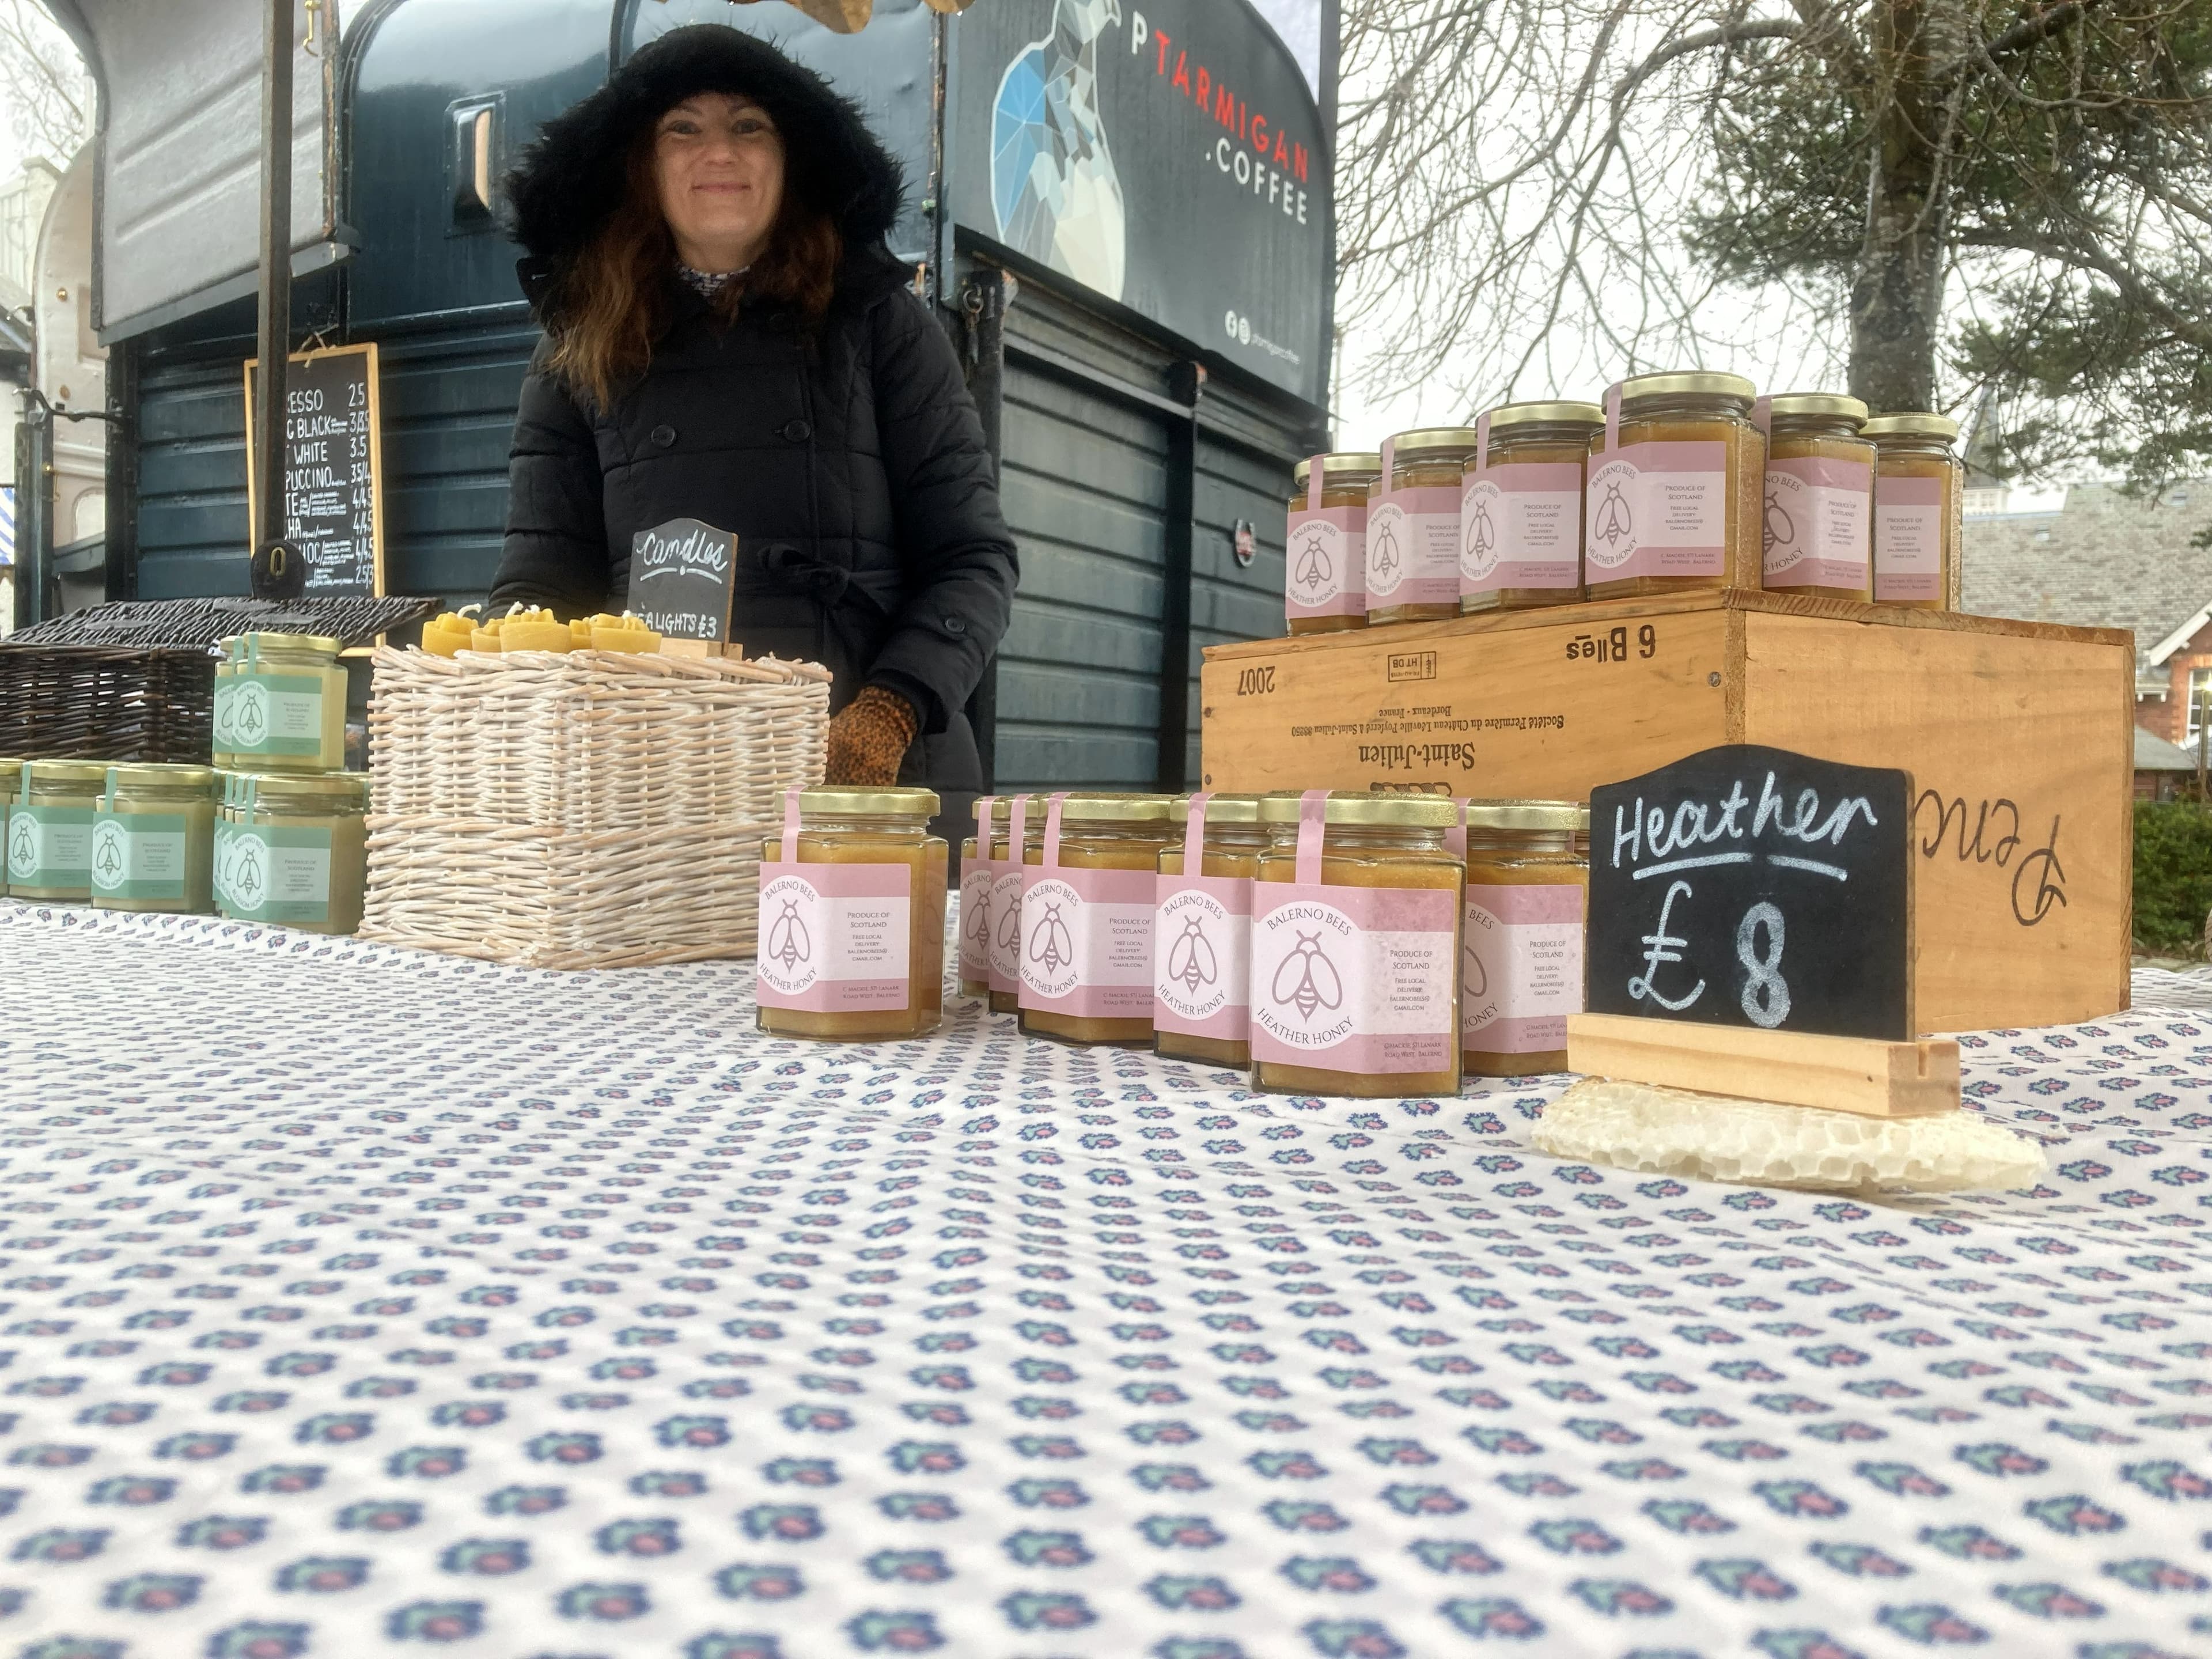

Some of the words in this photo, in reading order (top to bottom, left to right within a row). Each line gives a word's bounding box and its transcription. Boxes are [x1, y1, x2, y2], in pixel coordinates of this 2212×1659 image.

[1131, 10, 1309, 183] PTARMIGAN
[297, 415, 332, 438] BLACK
[294, 441, 328, 465] WHITE
[350, 435, 366, 457] 3.5
[1592, 465, 1622, 488] BALERNO
[1622, 465, 1637, 480] BEES
[1781, 476, 1802, 492] BEES
[1464, 484, 1487, 506] BALERNO
[1487, 485, 1498, 498] BEES
[1293, 523, 1322, 540] BALERNO
[1323, 525, 1337, 537] BEES
[637, 529, 728, 572] Candles
[1587, 546, 1614, 565] HEATHER
[1615, 536, 1638, 563] HONEY
[1771, 546, 1803, 571] HONEY
[1460, 559, 1481, 577] HEATHER
[1482, 552, 1499, 577] HONEY
[1287, 586, 1315, 604] HEATHER
[1316, 582, 1338, 604] HONEY
[698, 614, 717, 638] £3
[1638, 624, 1656, 658] 6
[1406, 657, 1418, 667] HT
[1237, 666, 1276, 696] 2007
[1379, 708, 1405, 719] France
[1412, 706, 1452, 717] Bordeaux
[1528, 715, 1565, 730] Société
[1315, 724, 1358, 736] Saint-Julien
[1366, 721, 1398, 734] Poyferré
[1400, 721, 1431, 733] Léoville
[1434, 719, 1468, 732] Château
[1470, 719, 1483, 731] du
[1484, 717, 1527, 731] Fermière
[1358, 742, 1475, 771] Saint-Julien
[1611, 771, 1879, 870] Heather
[765, 881, 798, 900] BALERNO
[800, 884, 816, 903] BEES
[963, 874, 991, 890] BALERNO
[1027, 884, 1062, 903] BALERNO
[1063, 888, 1079, 907] BEES
[1164, 896, 1203, 916] BALERNO
[1204, 899, 1224, 920] BEES
[1469, 909, 1495, 930] BEES
[1267, 907, 1324, 931] BALERNO
[1325, 912, 1352, 936] BEES
[990, 951, 1019, 978] HEATHER
[760, 963, 791, 991] HEATHER
[793, 966, 817, 991] HONEY
[1020, 965, 1053, 994] HEATHER
[1054, 971, 1079, 994] HONEY
[1158, 984, 1195, 1016] HEATHER
[1196, 989, 1226, 1016] HONEY
[1257, 1008, 1310, 1044] HEATHER
[1312, 1015, 1354, 1044] HONEY
